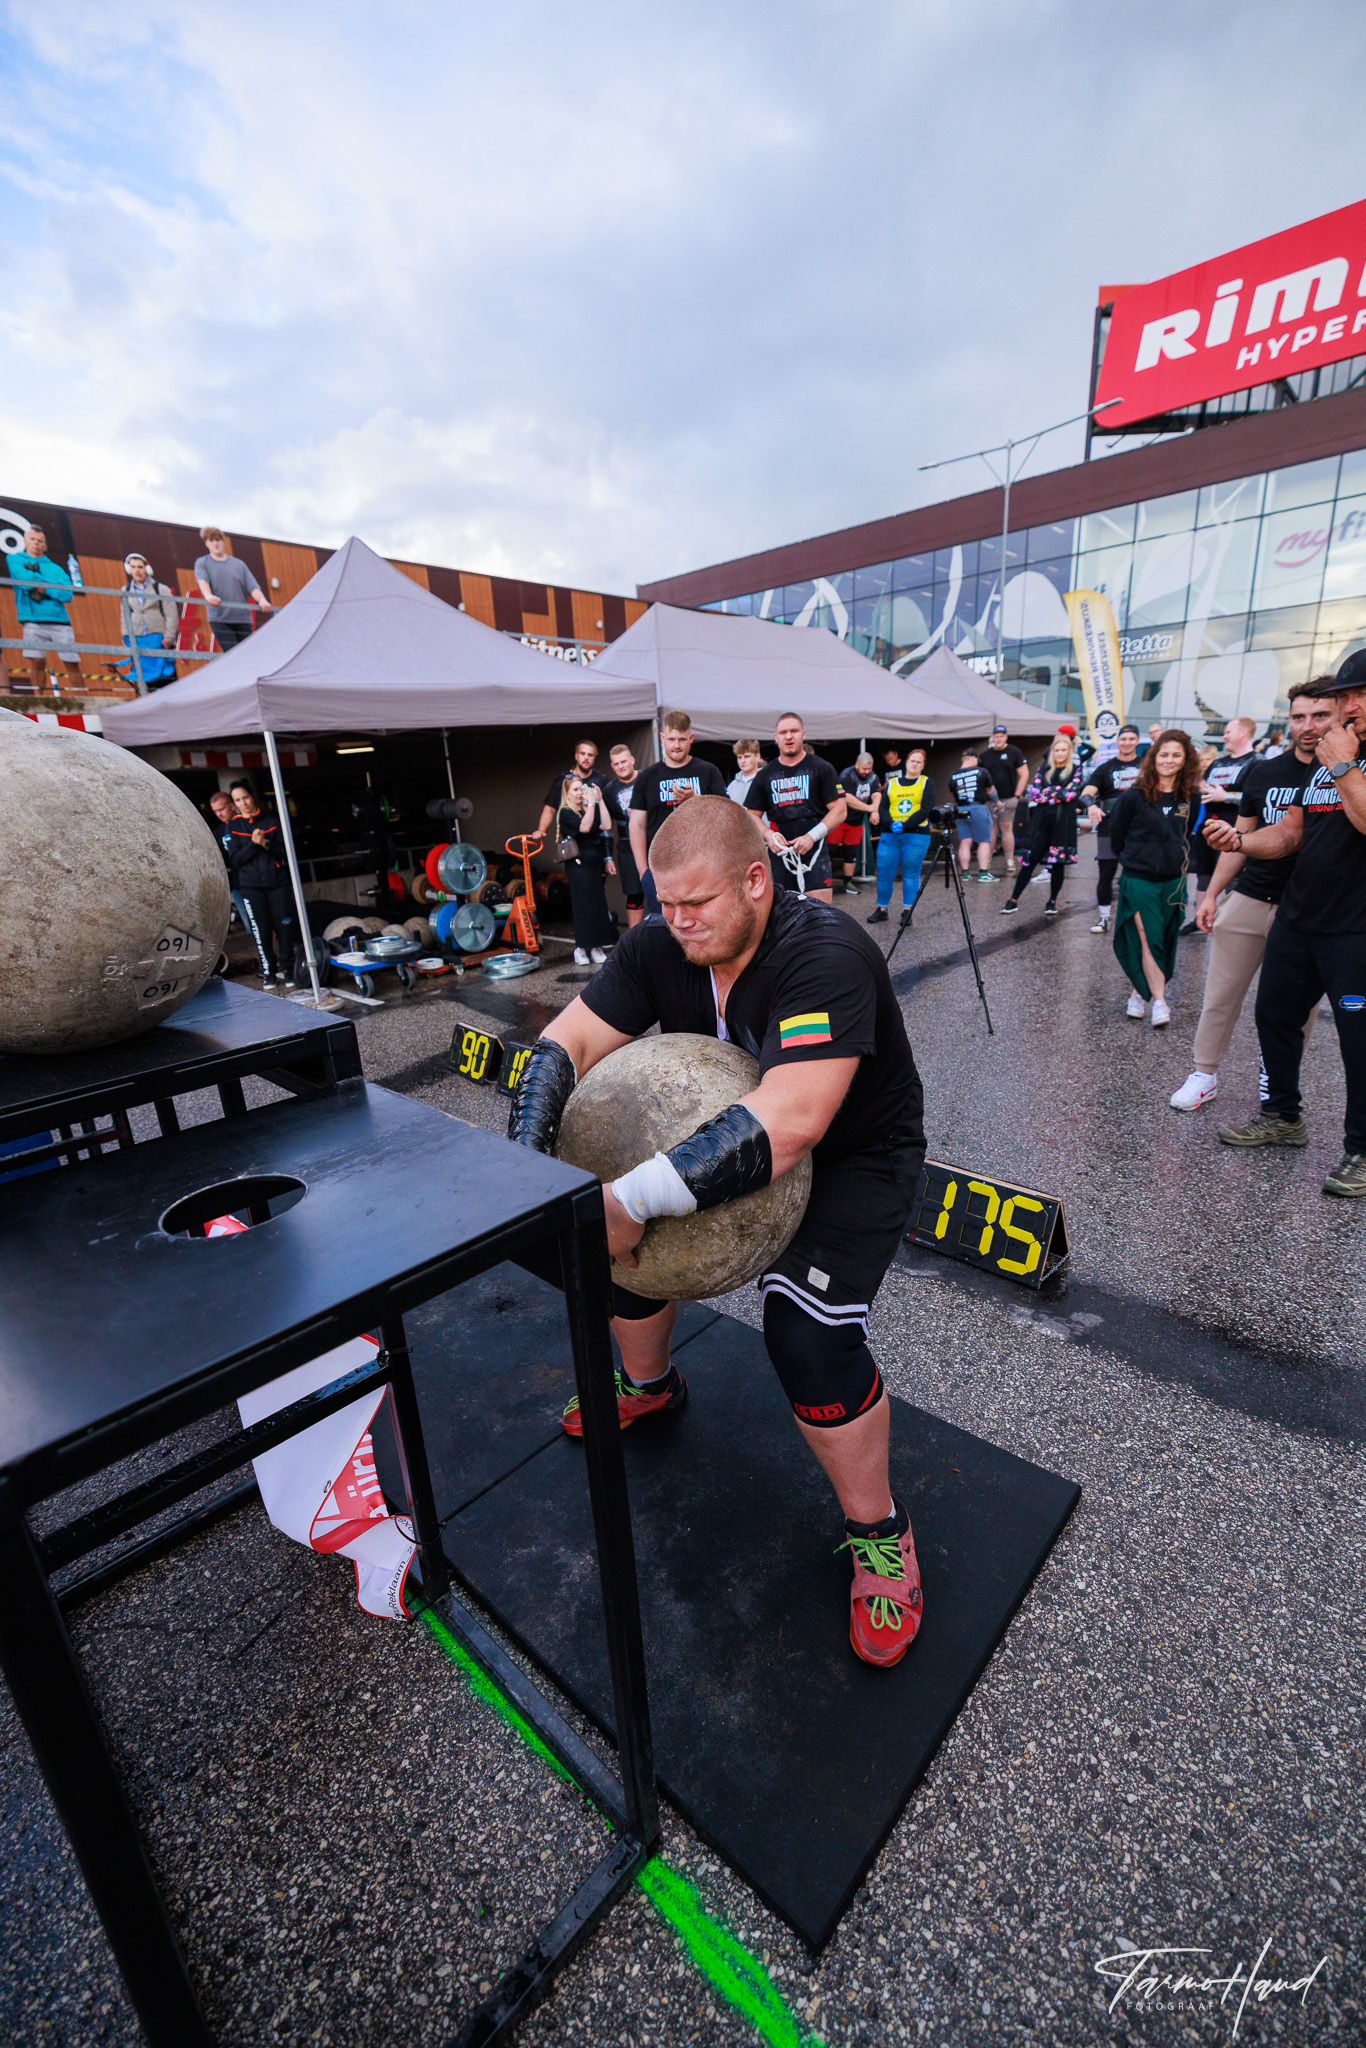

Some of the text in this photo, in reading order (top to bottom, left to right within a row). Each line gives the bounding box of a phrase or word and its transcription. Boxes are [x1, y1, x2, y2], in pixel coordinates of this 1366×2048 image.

[1134, 256, 1366, 373] Rim
[459, 1031, 489, 1080] 90
[935, 1180, 1042, 1276] 175
[798, 1405, 841, 1419] SBD
